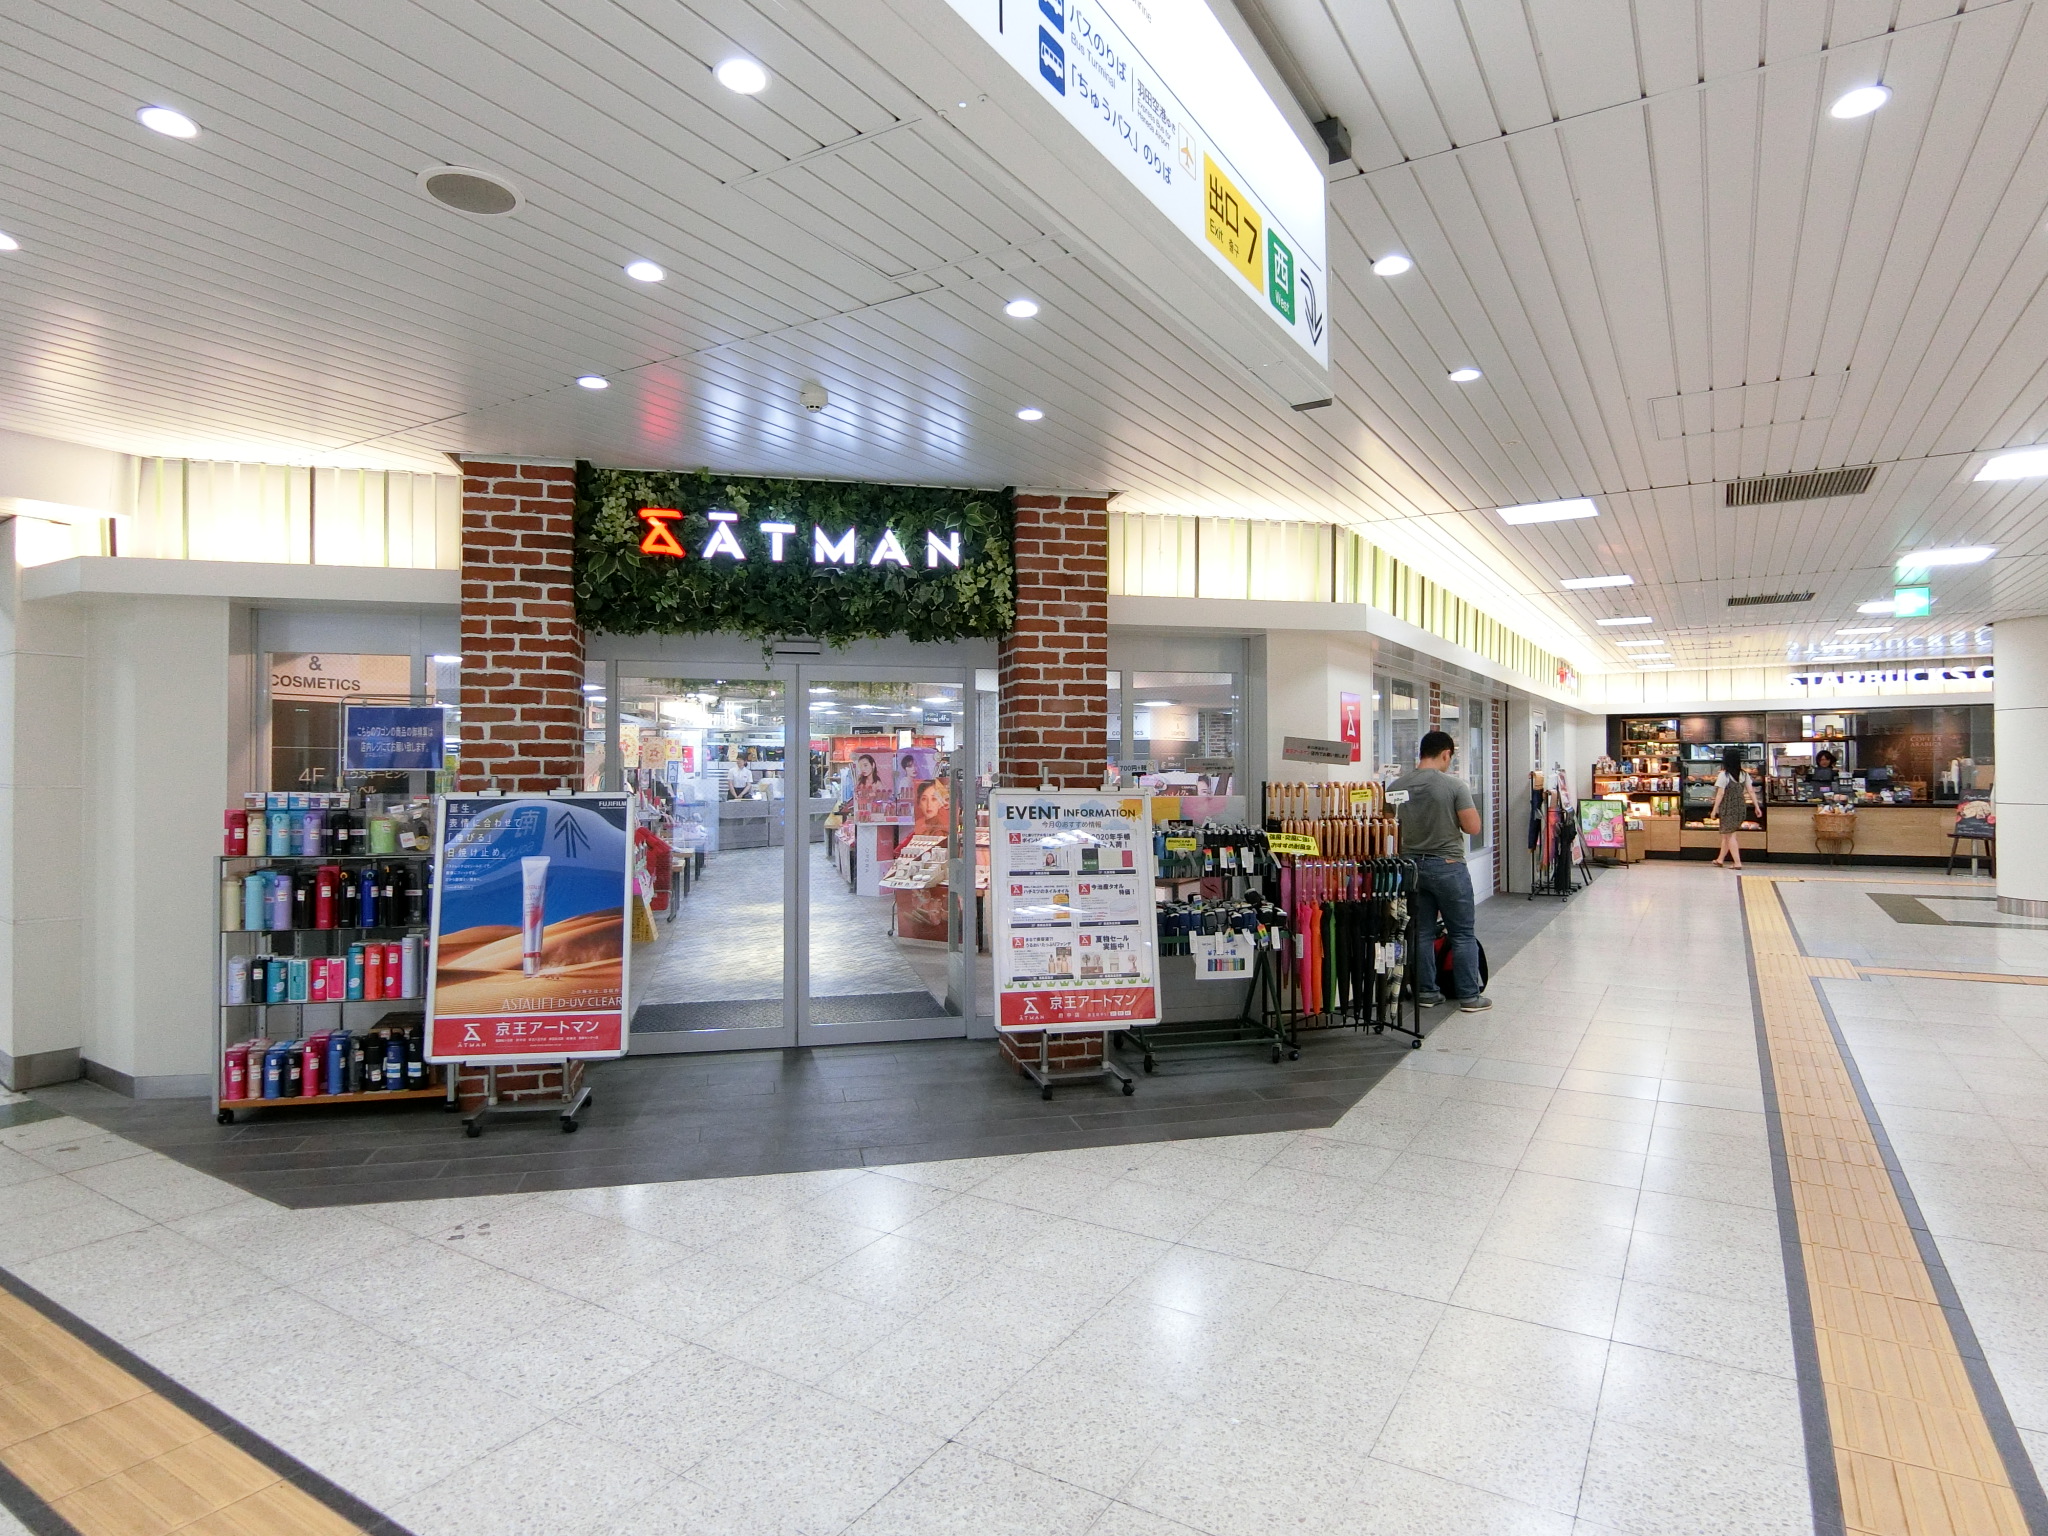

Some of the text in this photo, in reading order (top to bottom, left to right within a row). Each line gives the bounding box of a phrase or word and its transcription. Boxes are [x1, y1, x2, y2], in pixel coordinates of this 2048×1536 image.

[1070, 5, 1127, 82] バスのりば
[1071, 32, 1085, 56] Bus
[1209, 173, 1258, 265] 出口 7
[1209, 217, 1224, 245] Exit
[1273, 241, 1289, 295] 西
[1274, 289, 1291, 316] West
[308, 655, 323, 671] &
[271, 674, 361, 692] COSMETICS
[1785, 666, 1969, 687] STARBUCKS
[298, 767, 326, 786] 4F
[1006, 805, 1136, 820] EVENT INFORMATION
[449, 818, 522, 828] 表情に合わせて
[1041, 820, 1102, 829] 今月のおすすめ情報
[1095, 935, 1130, 944] 夏物セール
[502, 996, 622, 1011] ASTALIFT D-UV CLEAR
[1049, 994, 1137, 1010] 京王アートマン
[495, 1020, 600, 1036] 京王アートマン
